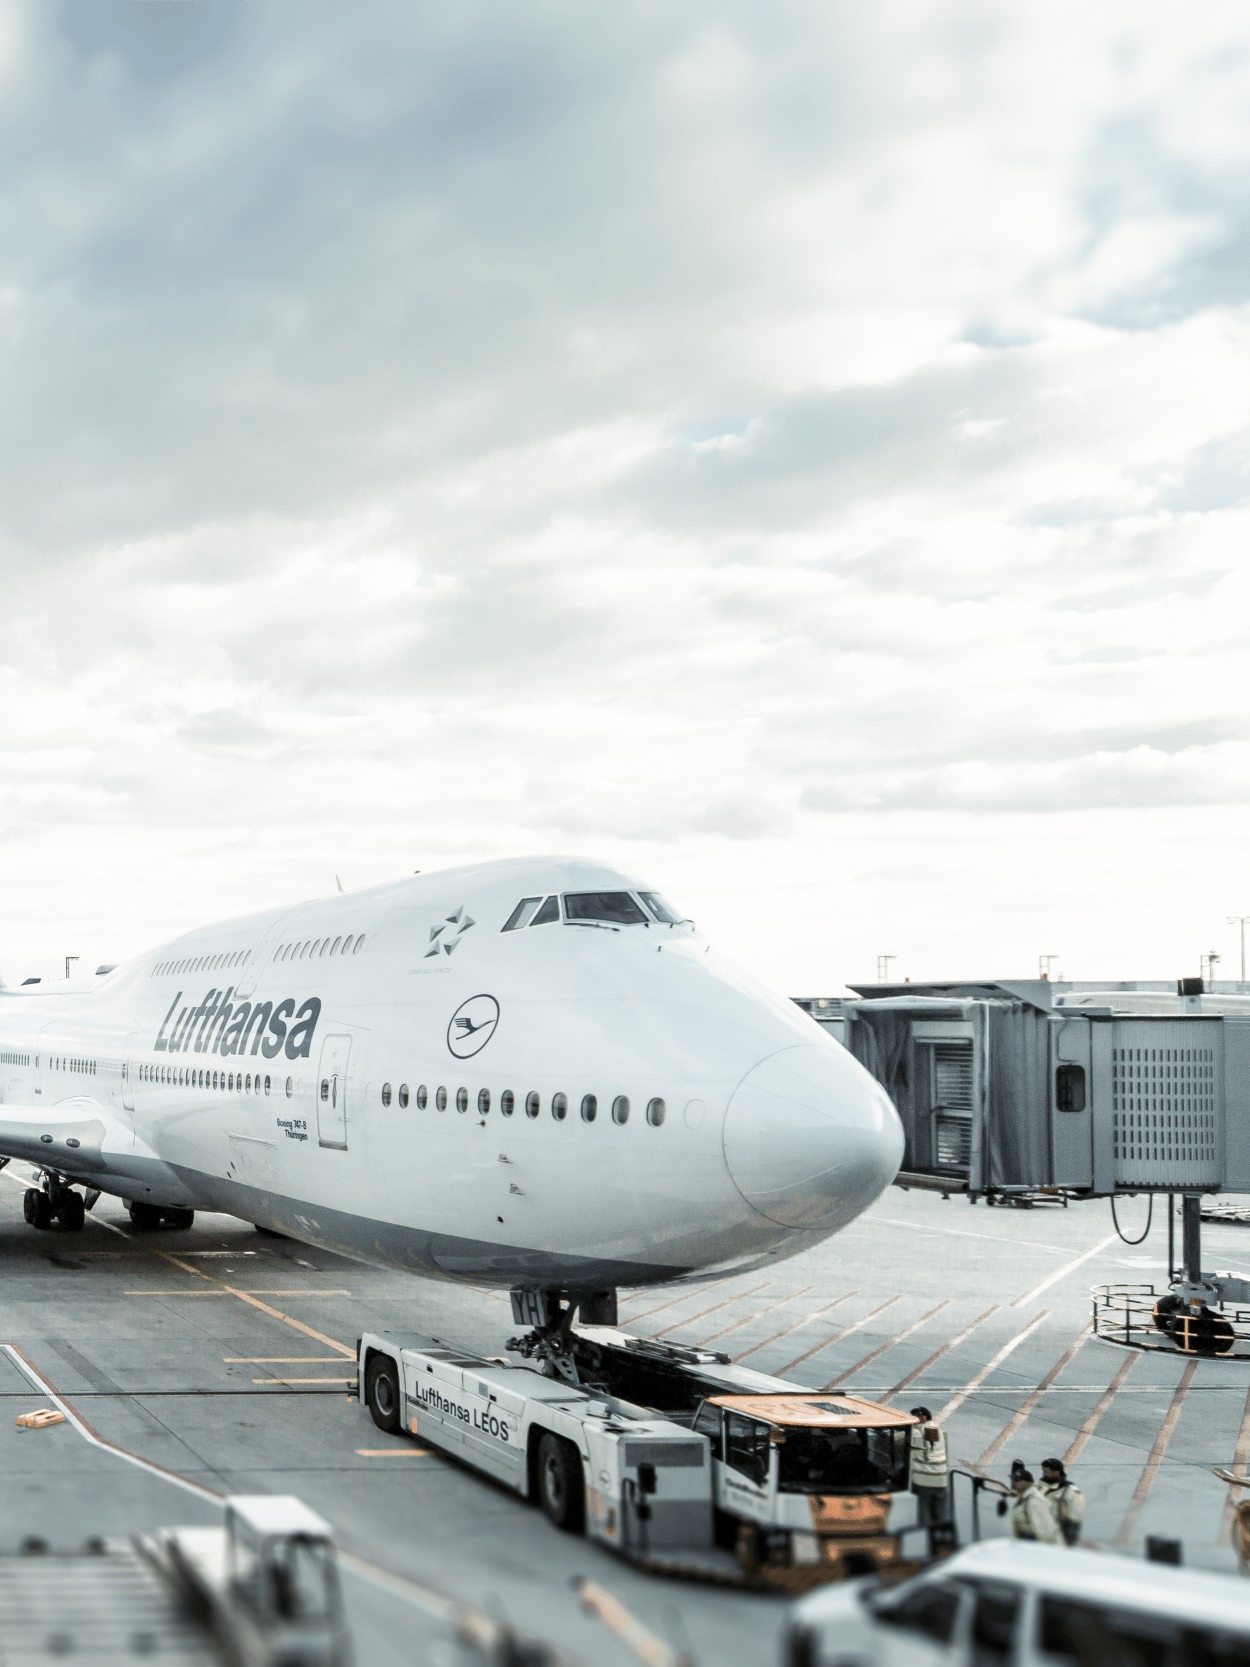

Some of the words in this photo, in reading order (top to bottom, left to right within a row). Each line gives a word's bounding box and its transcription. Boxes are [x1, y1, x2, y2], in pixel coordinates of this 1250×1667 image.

[153, 986, 322, 1060] Lufthansa
[276, 1117, 293, 1130] Boeing
[293, 1119, 307, 1130] 747-8
[415, 1380, 470, 1424] Lufthansa
[473, 1408, 509, 1442] LEOS
